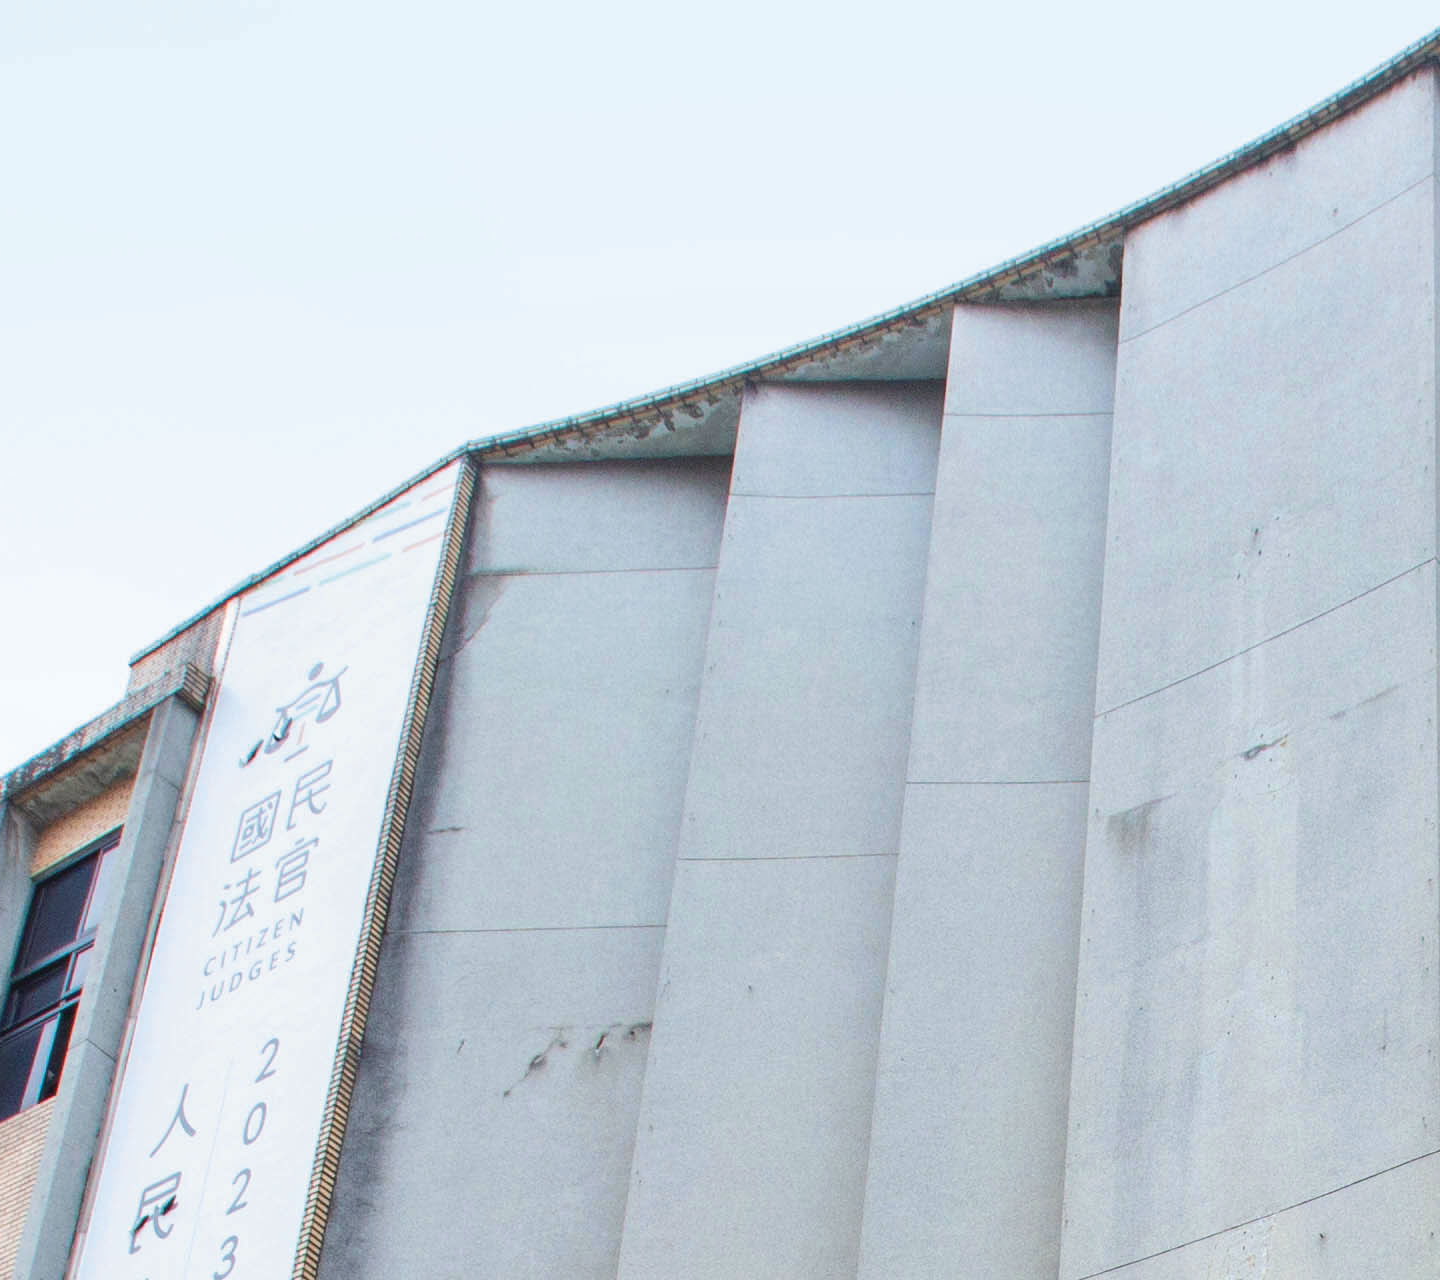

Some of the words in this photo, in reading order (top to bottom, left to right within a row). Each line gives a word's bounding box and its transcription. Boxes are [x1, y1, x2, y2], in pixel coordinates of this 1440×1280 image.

[230, 759, 335, 864] 國民
[212, 836, 319, 939] 法官
[195, 942, 298, 1010] JUDGES
[202, 907, 305, 977] CITIZEN
